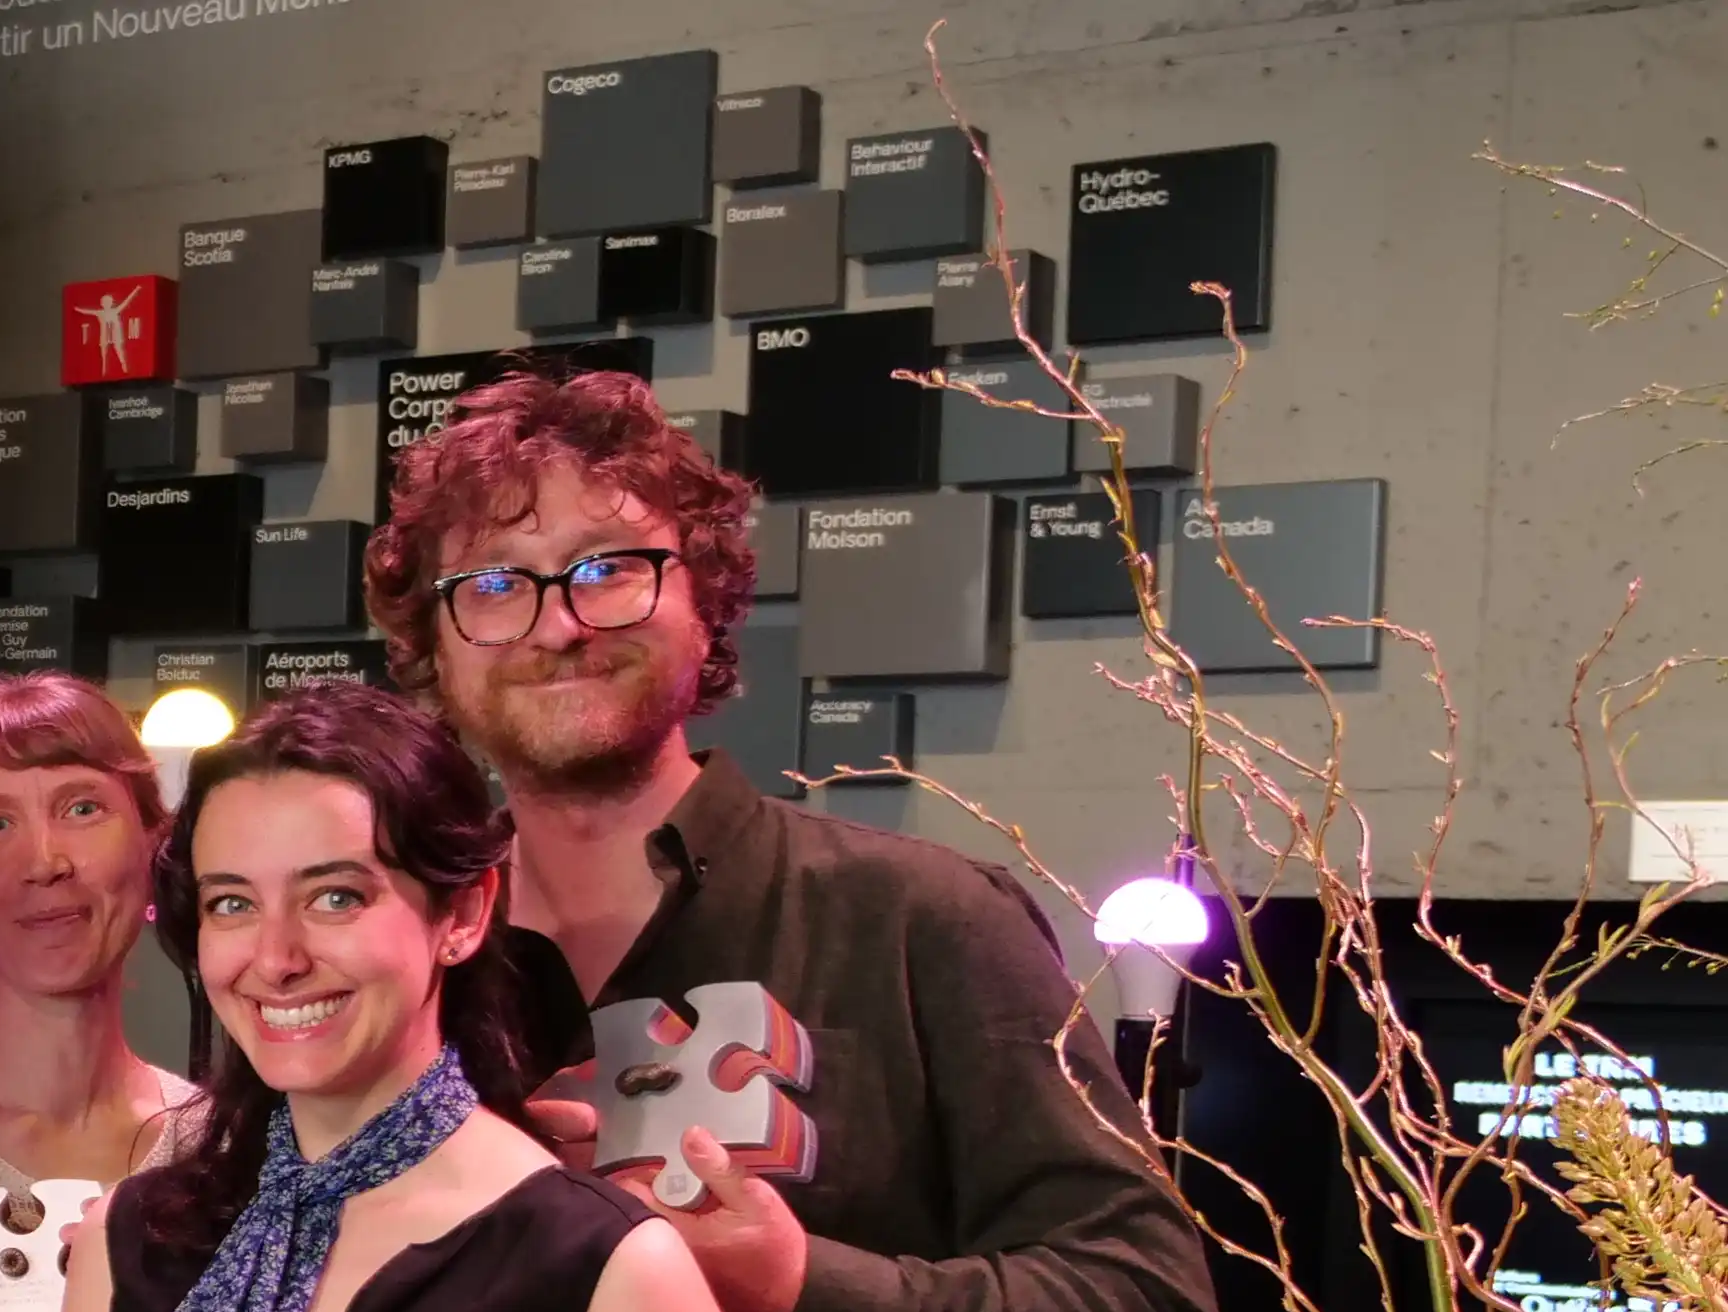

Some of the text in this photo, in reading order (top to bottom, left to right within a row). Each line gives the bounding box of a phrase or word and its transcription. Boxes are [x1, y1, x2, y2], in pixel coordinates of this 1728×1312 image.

[43, 22, 82, 50] un
[93, 0, 245, 42] Nouveau
[547, 71, 622, 95] Cogeco
[328, 150, 372, 168] KPMG
[851, 138, 933, 160] Behaviour
[1080, 168, 1161, 195] Hydro-
[1078, 190, 1170, 214] Québec
[727, 204, 786, 223] Boralex
[184, 228, 246, 250] Banque
[184, 250, 233, 267] Scotia
[757, 327, 810, 350] BMO
[389, 371, 465, 395] Power
[107, 488, 190, 510] Desjardins
[1184, 499, 1220, 517] Ar
[808, 508, 913, 529] Fondation
[1029, 502, 1077, 520] Ernst
[255, 527, 308, 543] Sun Life
[1029, 520, 1101, 539] & Young
[808, 531, 884, 549] Molson
[2, 634, 27, 647] Guy
[158, 652, 215, 666] Christian
[265, 651, 349, 672] Aéroports
[265, 672, 287, 688] de
